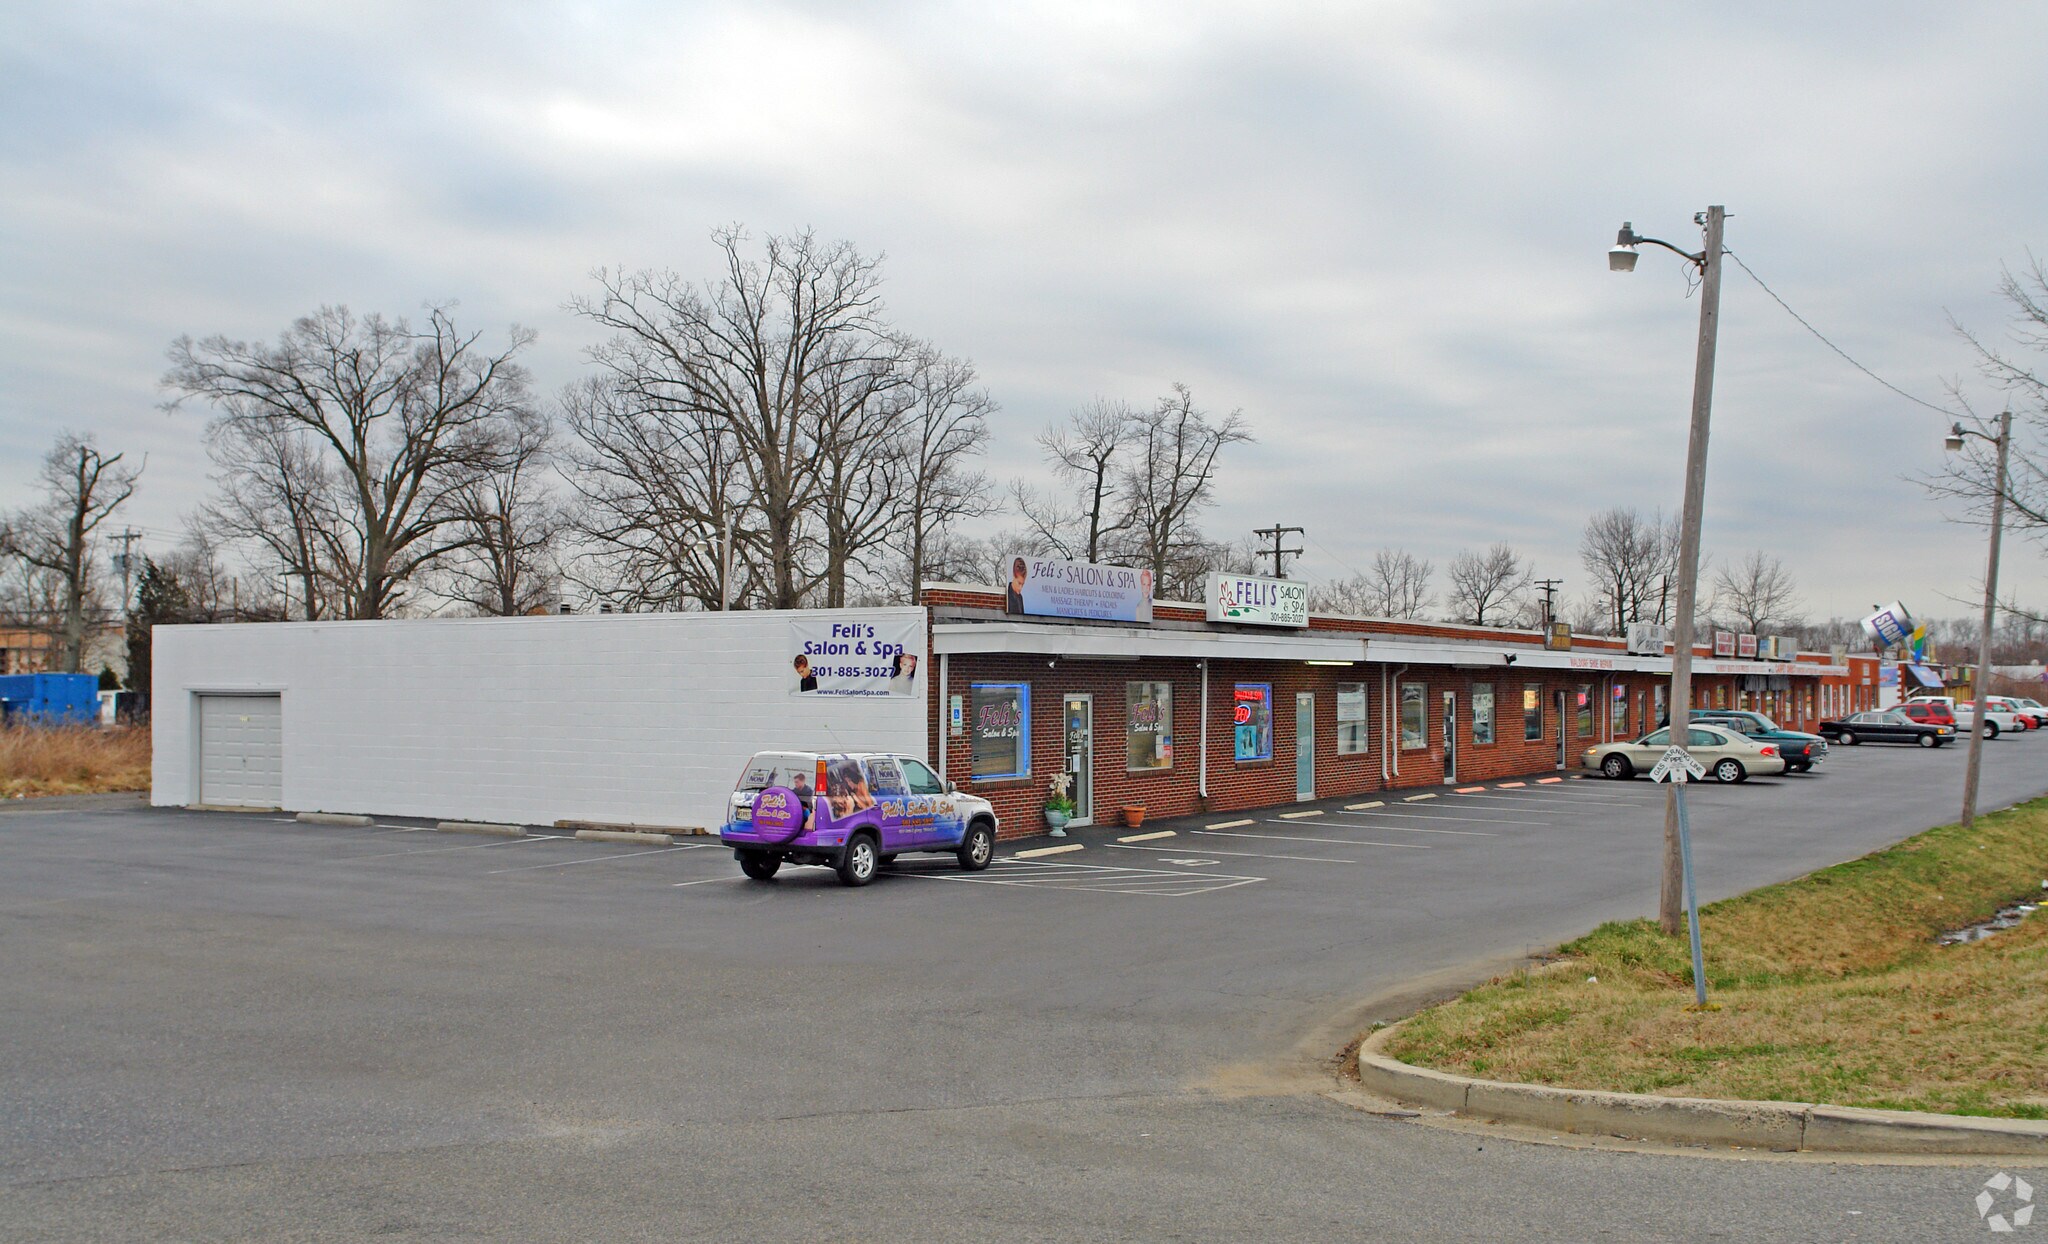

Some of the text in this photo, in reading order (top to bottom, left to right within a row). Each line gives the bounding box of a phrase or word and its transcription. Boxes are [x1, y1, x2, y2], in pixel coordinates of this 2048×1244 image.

[1066, 566, 1103, 586] SALON
[1106, 570, 1115, 588] &
[1117, 571, 1137, 590] SPA
[1236, 581, 1305, 606] FELI'S SALON
[1291, 600, 1305, 613] SPA
[1270, 612, 1304, 624] 301-885-3027
[832, 623, 875, 638] Feli's
[803, 640, 904, 660] Salon & Spa
[811, 666, 896, 678] 301-885-3027
[816, 688, 890, 697] www.FeliSalonSpa.com
[1007, 727, 1020, 740] Spa
[1662, 748, 1691, 762] WARNING
[1653, 763, 1665, 776] GAS
[1690, 760, 1704, 774] LINE
[881, 798, 905, 820] Feli's
[938, 800, 955, 816] Spa
